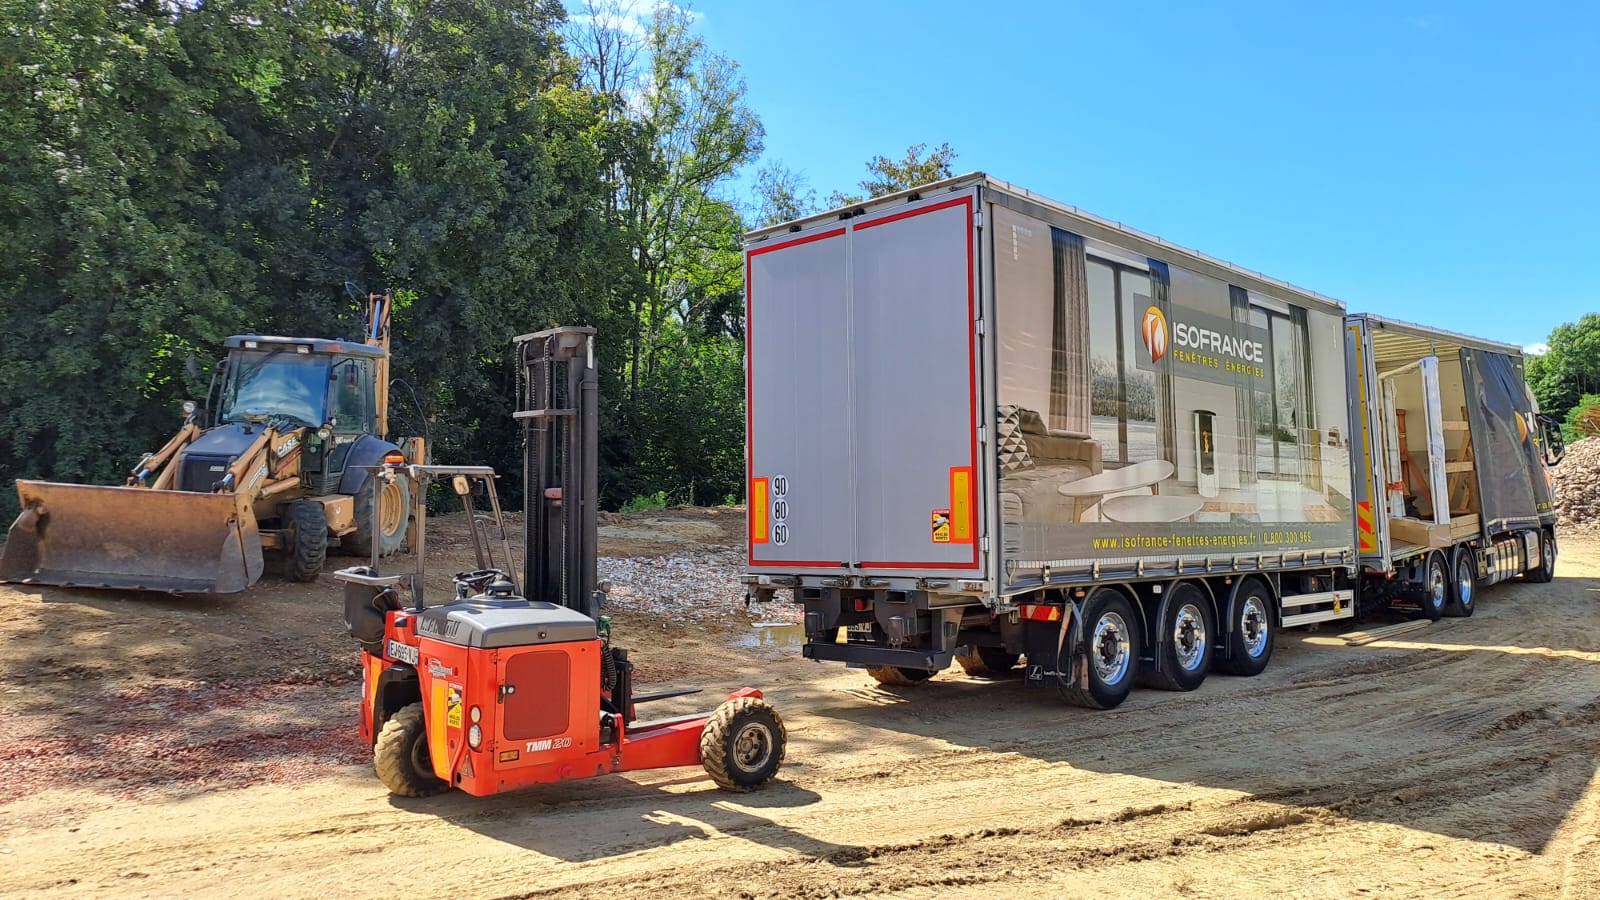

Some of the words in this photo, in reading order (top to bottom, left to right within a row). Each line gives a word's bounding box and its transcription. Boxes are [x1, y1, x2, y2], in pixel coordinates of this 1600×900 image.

[1173, 321, 1264, 363] ISOFRANCE
[277, 437, 298, 458] CASE
[774, 477, 786, 496] 90
[774, 501, 786, 520] 80
[774, 525, 787, 544] 60
[1092, 531, 1257, 550] www.isofrance-fenetres-energies.fr
[420, 616, 461, 639] MANOU
[526, 739, 552, 753] TMM
[552, 737, 572, 749] 20
